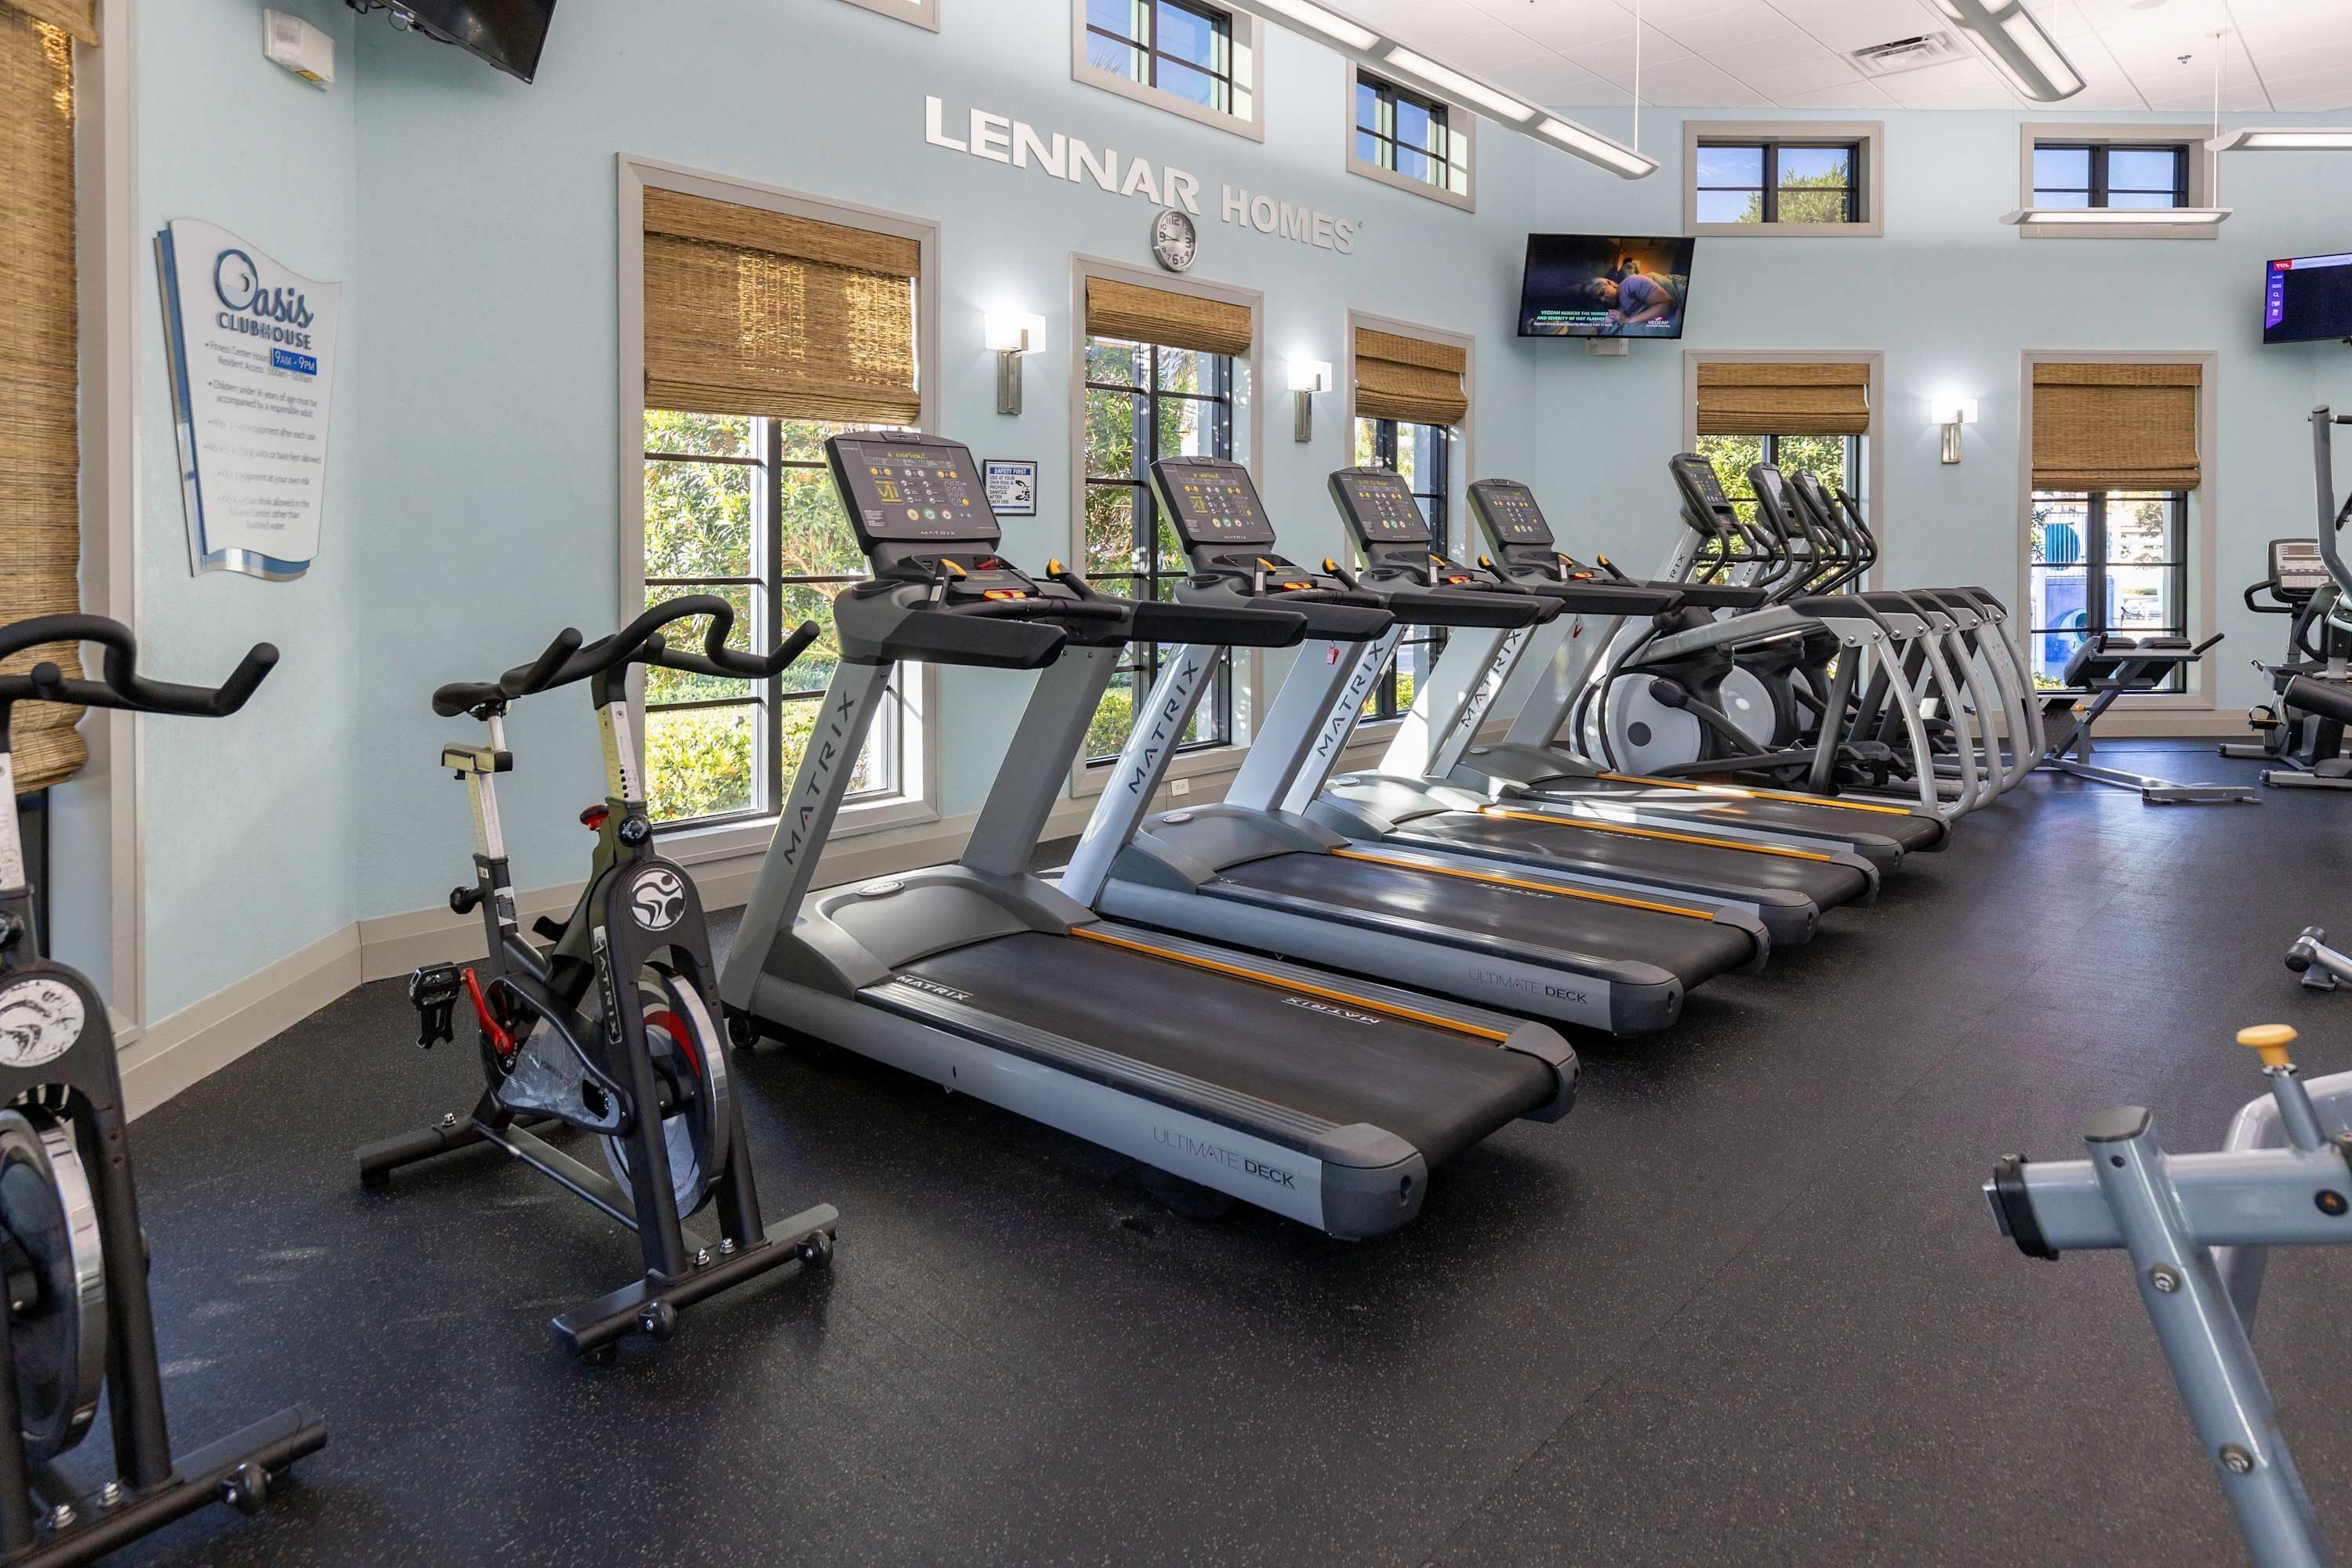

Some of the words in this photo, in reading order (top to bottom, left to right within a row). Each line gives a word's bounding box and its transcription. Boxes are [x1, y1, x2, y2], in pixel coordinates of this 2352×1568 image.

[924, 94, 1201, 216] LENNAR
[1221, 183, 1356, 255] HOMES
[1172, 254, 1178, 265] 6
[1185, 237, 1192, 249] 3
[214, 249, 314, 328] Oasis
[216, 311, 312, 350] CLUBHOUSE
[274, 350, 292, 365] 9AM
[298, 356, 315, 372] 9PM
[213, 379, 238, 392] Children
[239, 385, 256, 395] under
[257, 400, 264, 411] by
[1461, 630, 1522, 728] MATRIX
[1316, 641, 1385, 758] MATRIX
[1127, 658, 1200, 796] MATRIX
[783, 689, 855, 866] MATRIX
[593, 936, 618, 1036] MATRIX
[896, 975, 970, 1001] MATRIX
[1468, 965, 1541, 994] ULTIMATE
[1544, 984, 1588, 1004] DECK
[1286, 996, 1381, 1023] MATRIX
[1153, 1125, 1240, 1170] ULTIMATE
[1244, 1159, 1295, 1189] DECK
